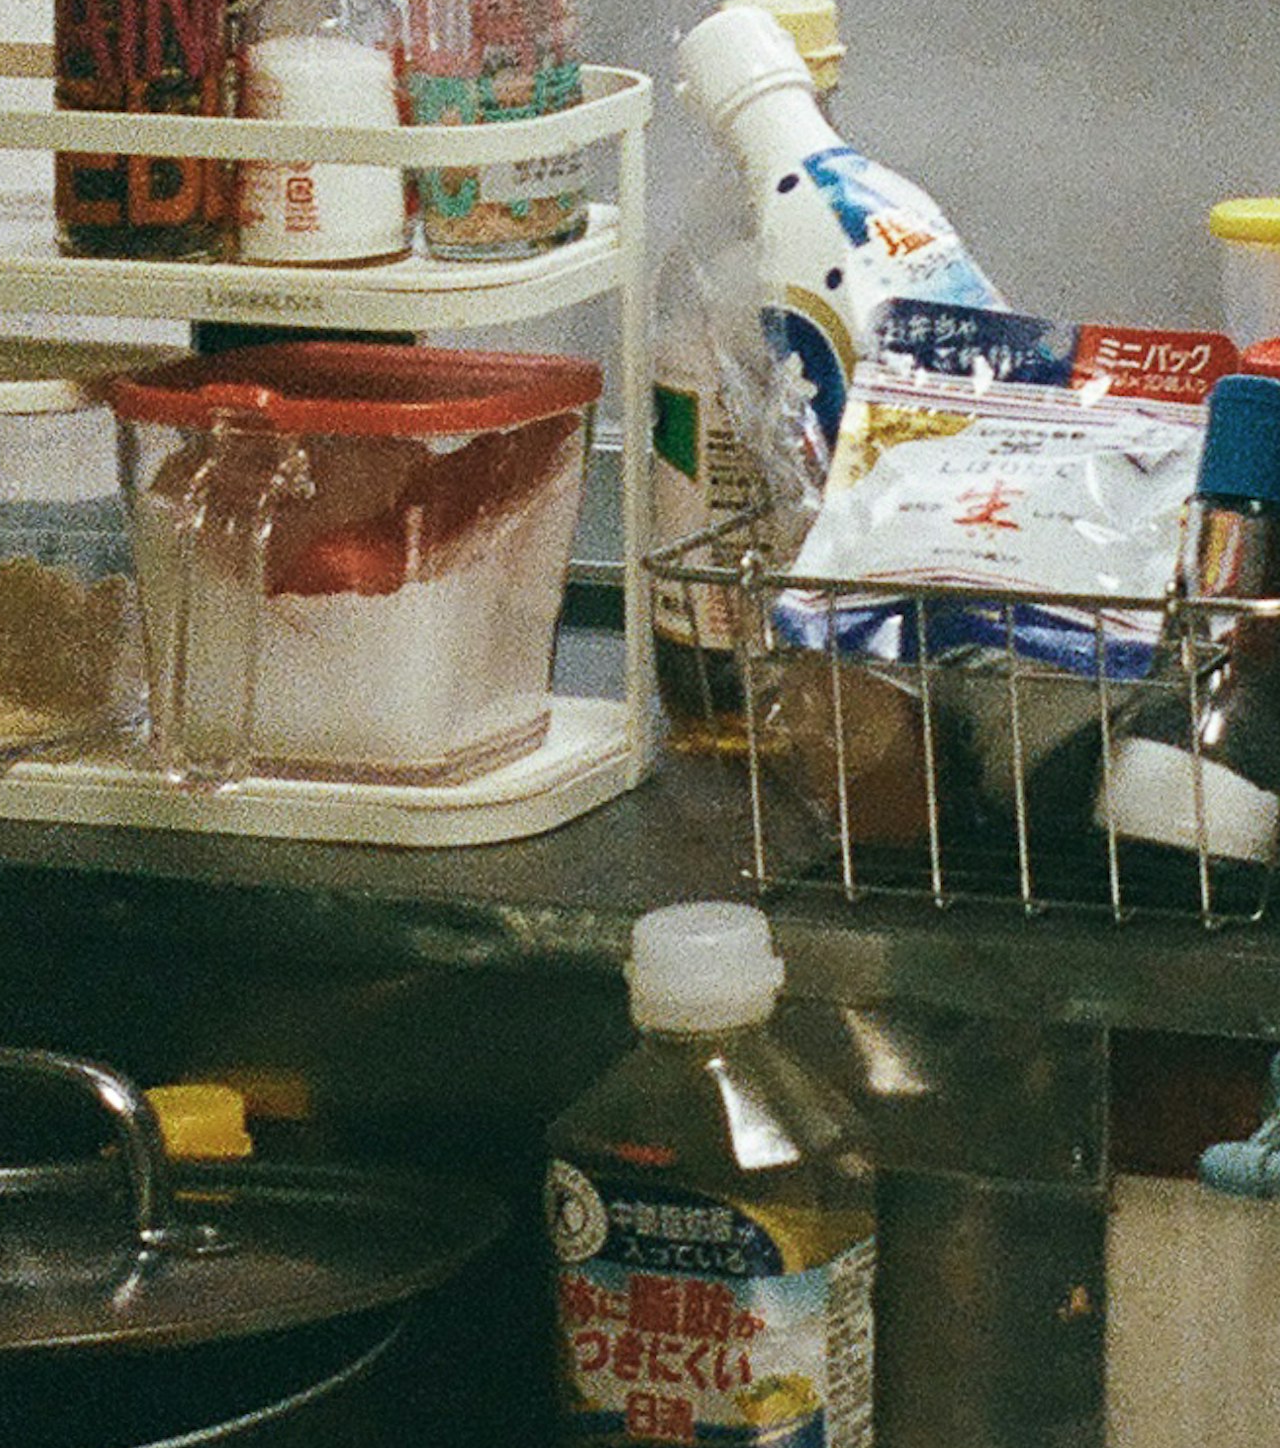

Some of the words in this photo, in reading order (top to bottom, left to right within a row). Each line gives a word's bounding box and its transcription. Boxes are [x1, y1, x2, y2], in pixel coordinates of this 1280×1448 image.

[1095, 337, 1211, 375] ミニパック
[953, 479, 1026, 531] 生
[622, 1235, 749, 1275] 入っている
[573, 1329, 753, 1393] つきにくい
[625, 1390, 693, 1445] 日清
